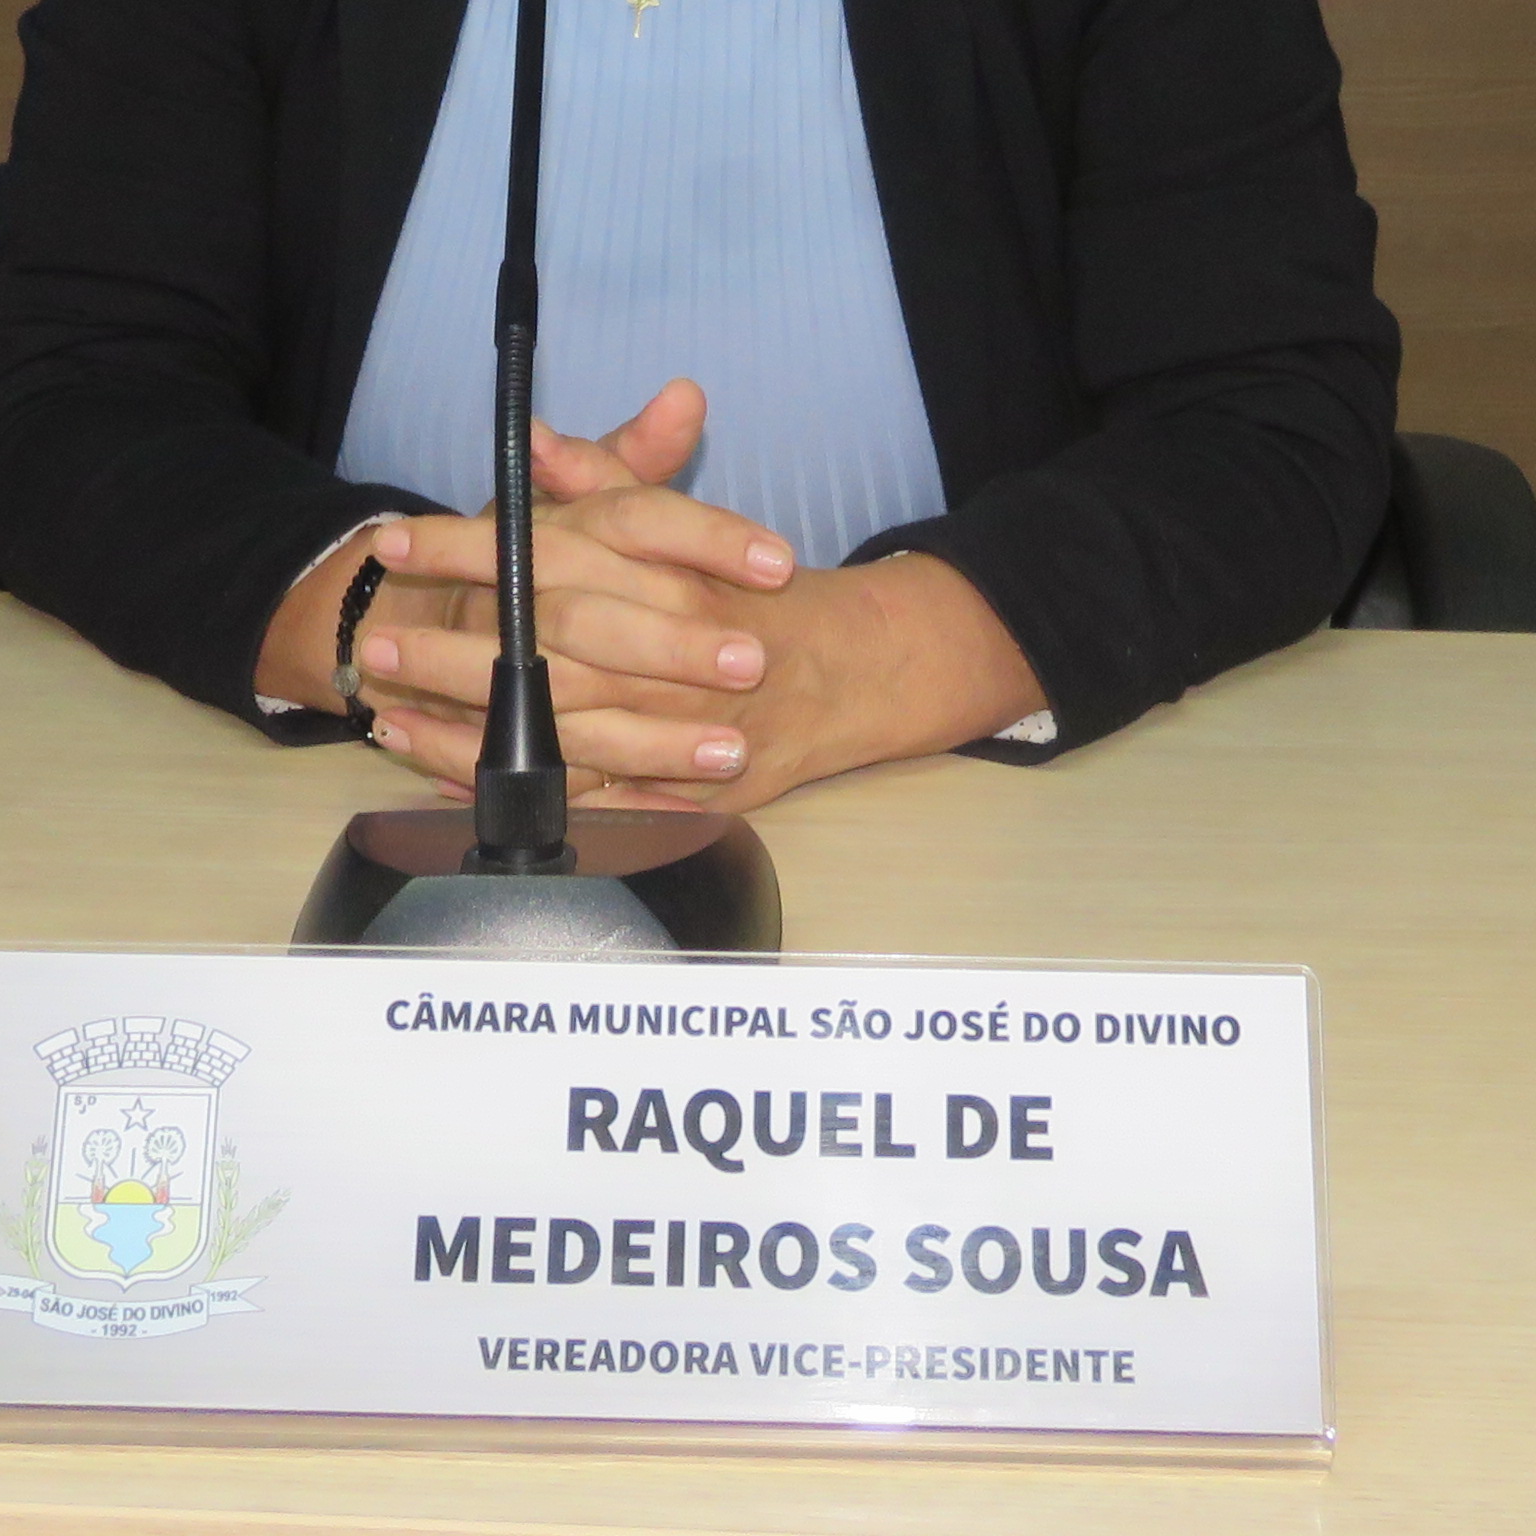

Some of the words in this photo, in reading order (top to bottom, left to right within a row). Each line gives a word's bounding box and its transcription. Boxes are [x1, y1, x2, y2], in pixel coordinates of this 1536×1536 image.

[385, 992, 558, 1034] CÂMARA
[568, 1003, 798, 1039] MUNICIPAL
[809, 999, 893, 1041] SÃO
[904, 1000, 1011, 1042] JOSÉ
[1022, 1010, 1082, 1044] DO
[1094, 1012, 1242, 1047] DIVINO
[566, 1086, 917, 1174] RAQUEL
[945, 1092, 1055, 1162] DE
[413, 1214, 878, 1292] MEDEIROS
[902, 1222, 1211, 1300] SOUSA
[39, 1296, 74, 1317] SÃO
[76, 1303, 118, 1322] JOSÉ
[122, 1306, 146, 1322] DO
[150, 1298, 204, 1321] DIVINO
[210, 1289, 238, 1302] 1992
[101, 1324, 138, 1337] 1992
[477, 1336, 740, 1376] VEREADORA
[748, 1342, 1136, 1384] VICE-PRESIDENTE
